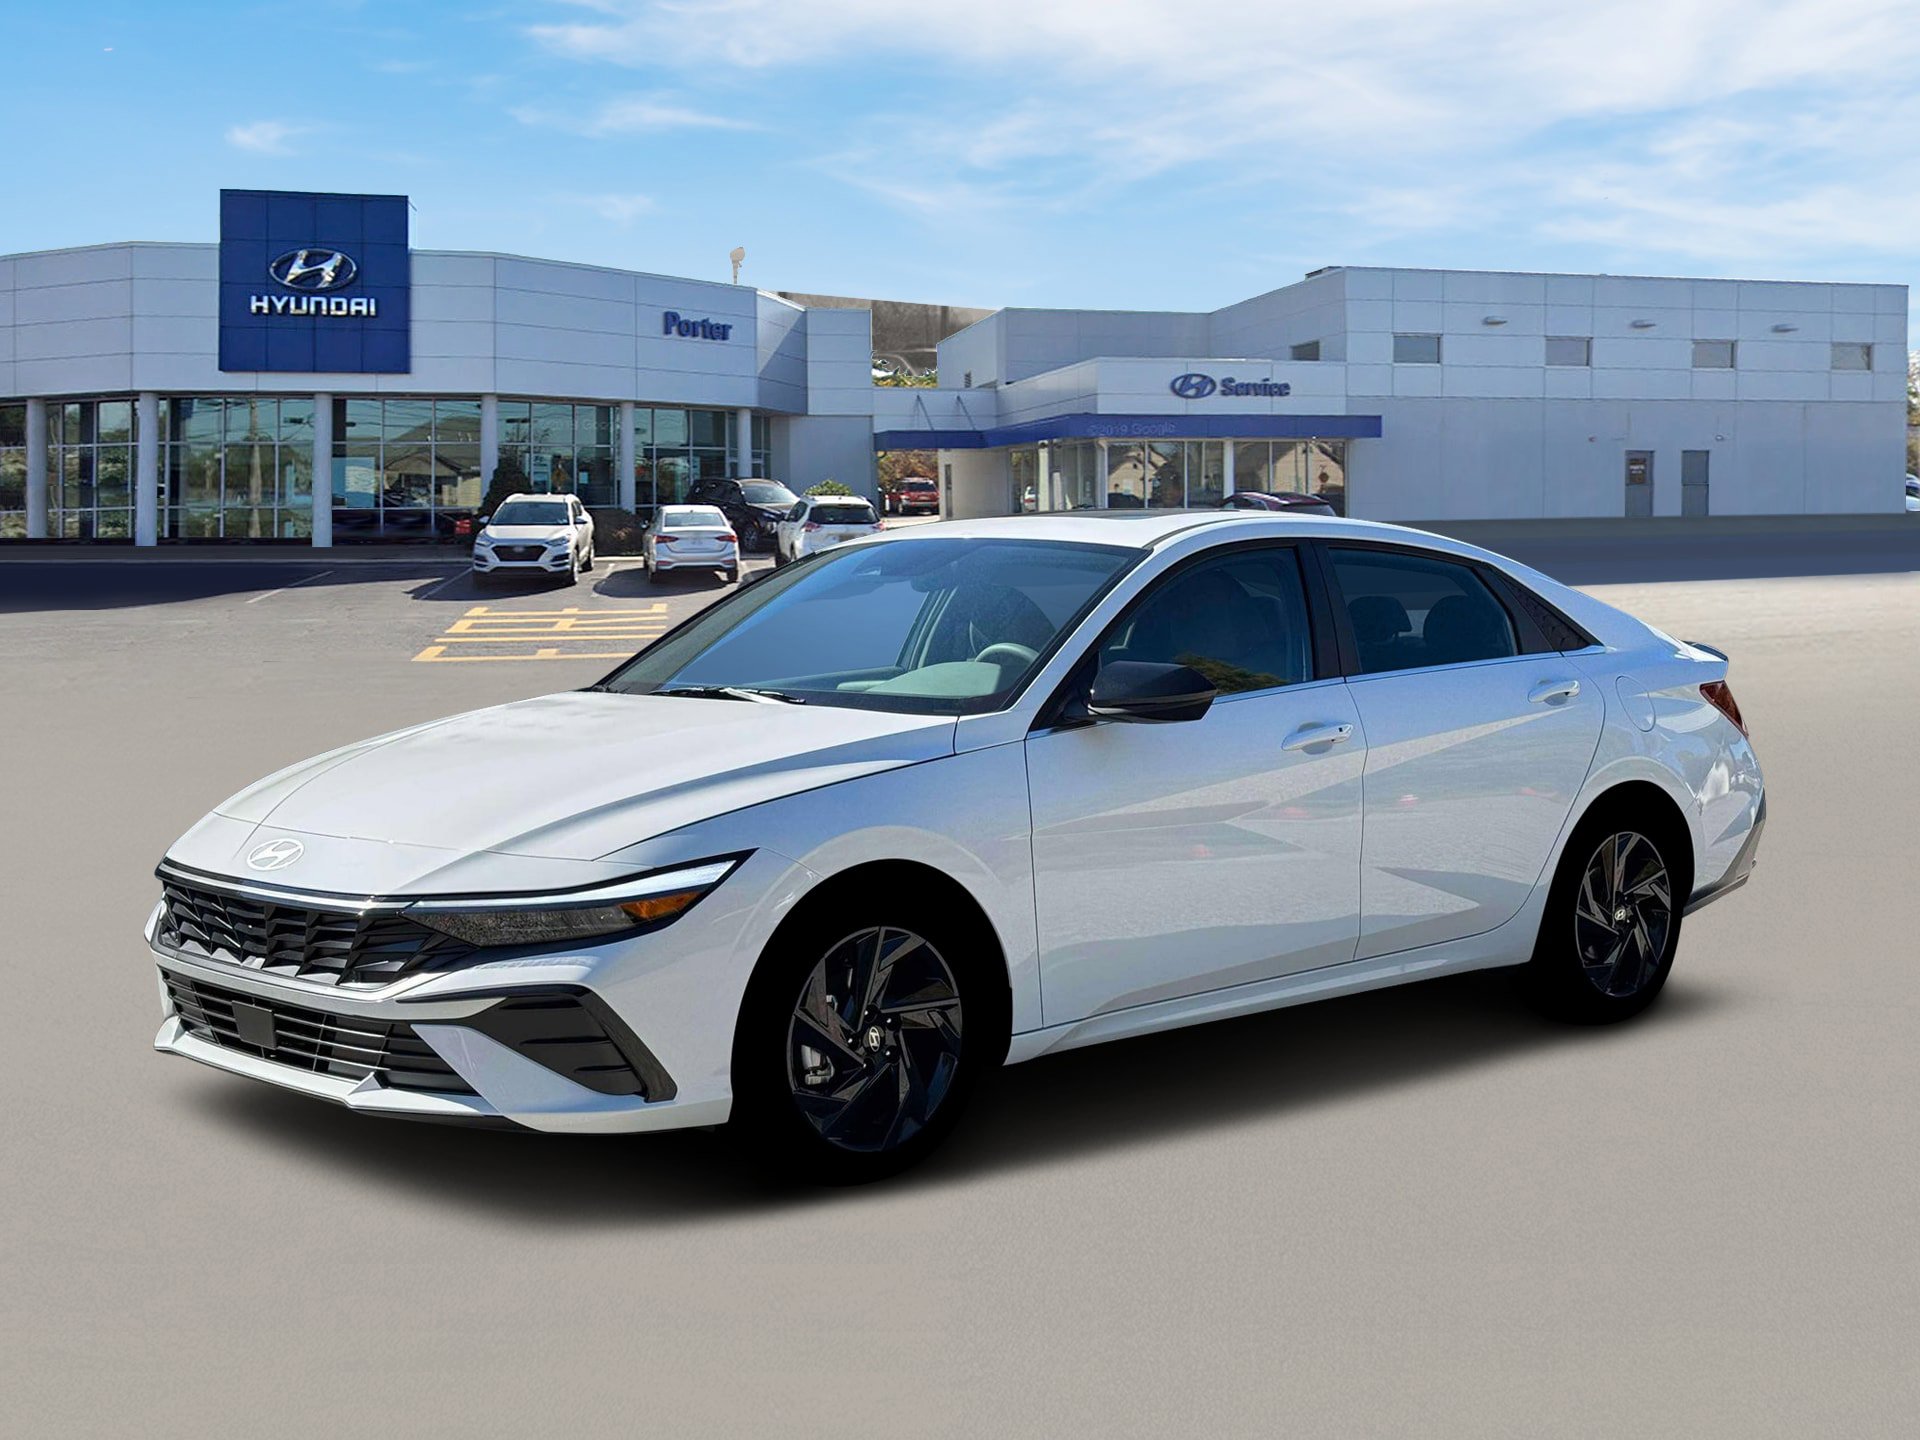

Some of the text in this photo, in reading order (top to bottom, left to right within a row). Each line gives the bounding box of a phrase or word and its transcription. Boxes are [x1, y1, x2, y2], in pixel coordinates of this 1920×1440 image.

[250, 295, 377, 317] HYUNDAI
[663, 311, 733, 341] Porter
[1220, 377, 1291, 397] Service
[411, 603, 669, 662] FIRE
